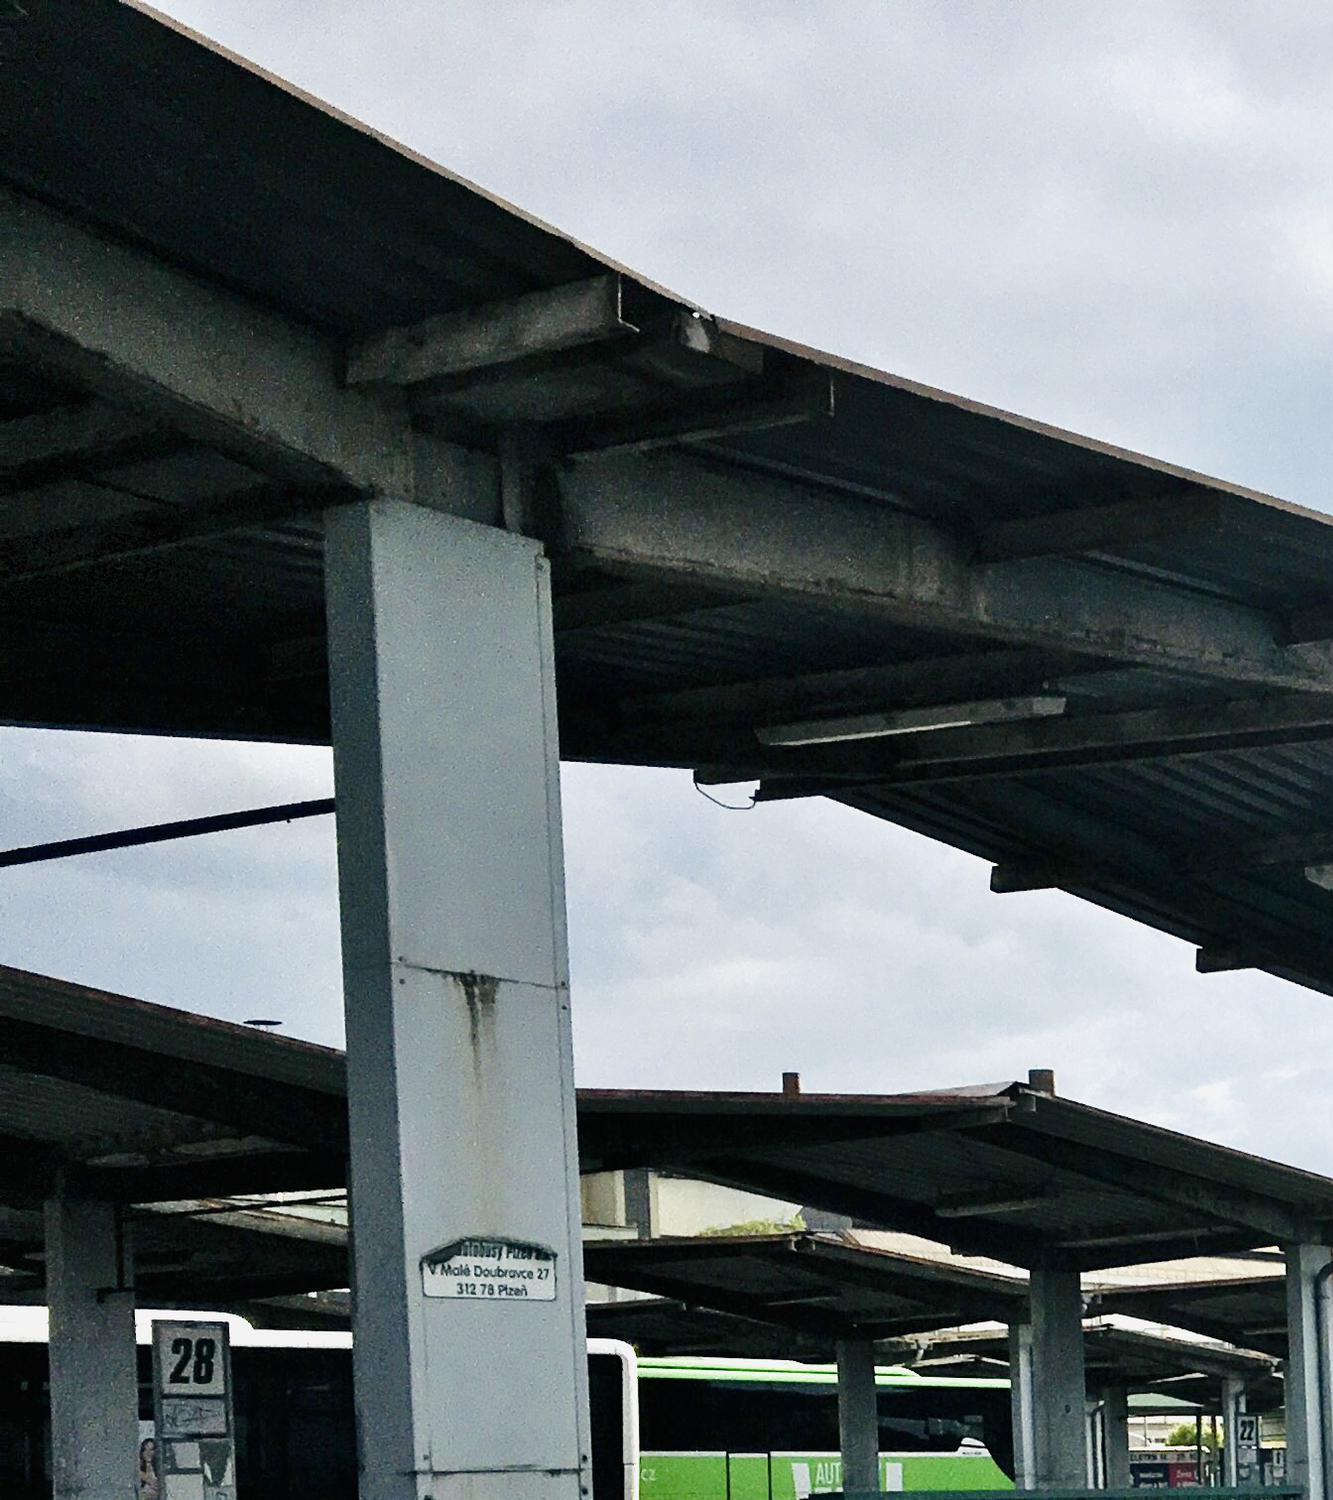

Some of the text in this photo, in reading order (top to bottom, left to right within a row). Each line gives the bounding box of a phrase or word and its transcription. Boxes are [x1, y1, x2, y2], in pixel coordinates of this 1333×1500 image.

[440, 1263, 471, 1277] Malé
[474, 1265, 534, 1280] Doubravce
[537, 1268, 550, 1280] 27
[456, 1283, 528, 1297] 312 78 Plzeň
[169, 1337, 216, 1385] 28
[1240, 1420, 1254, 1441] 22
